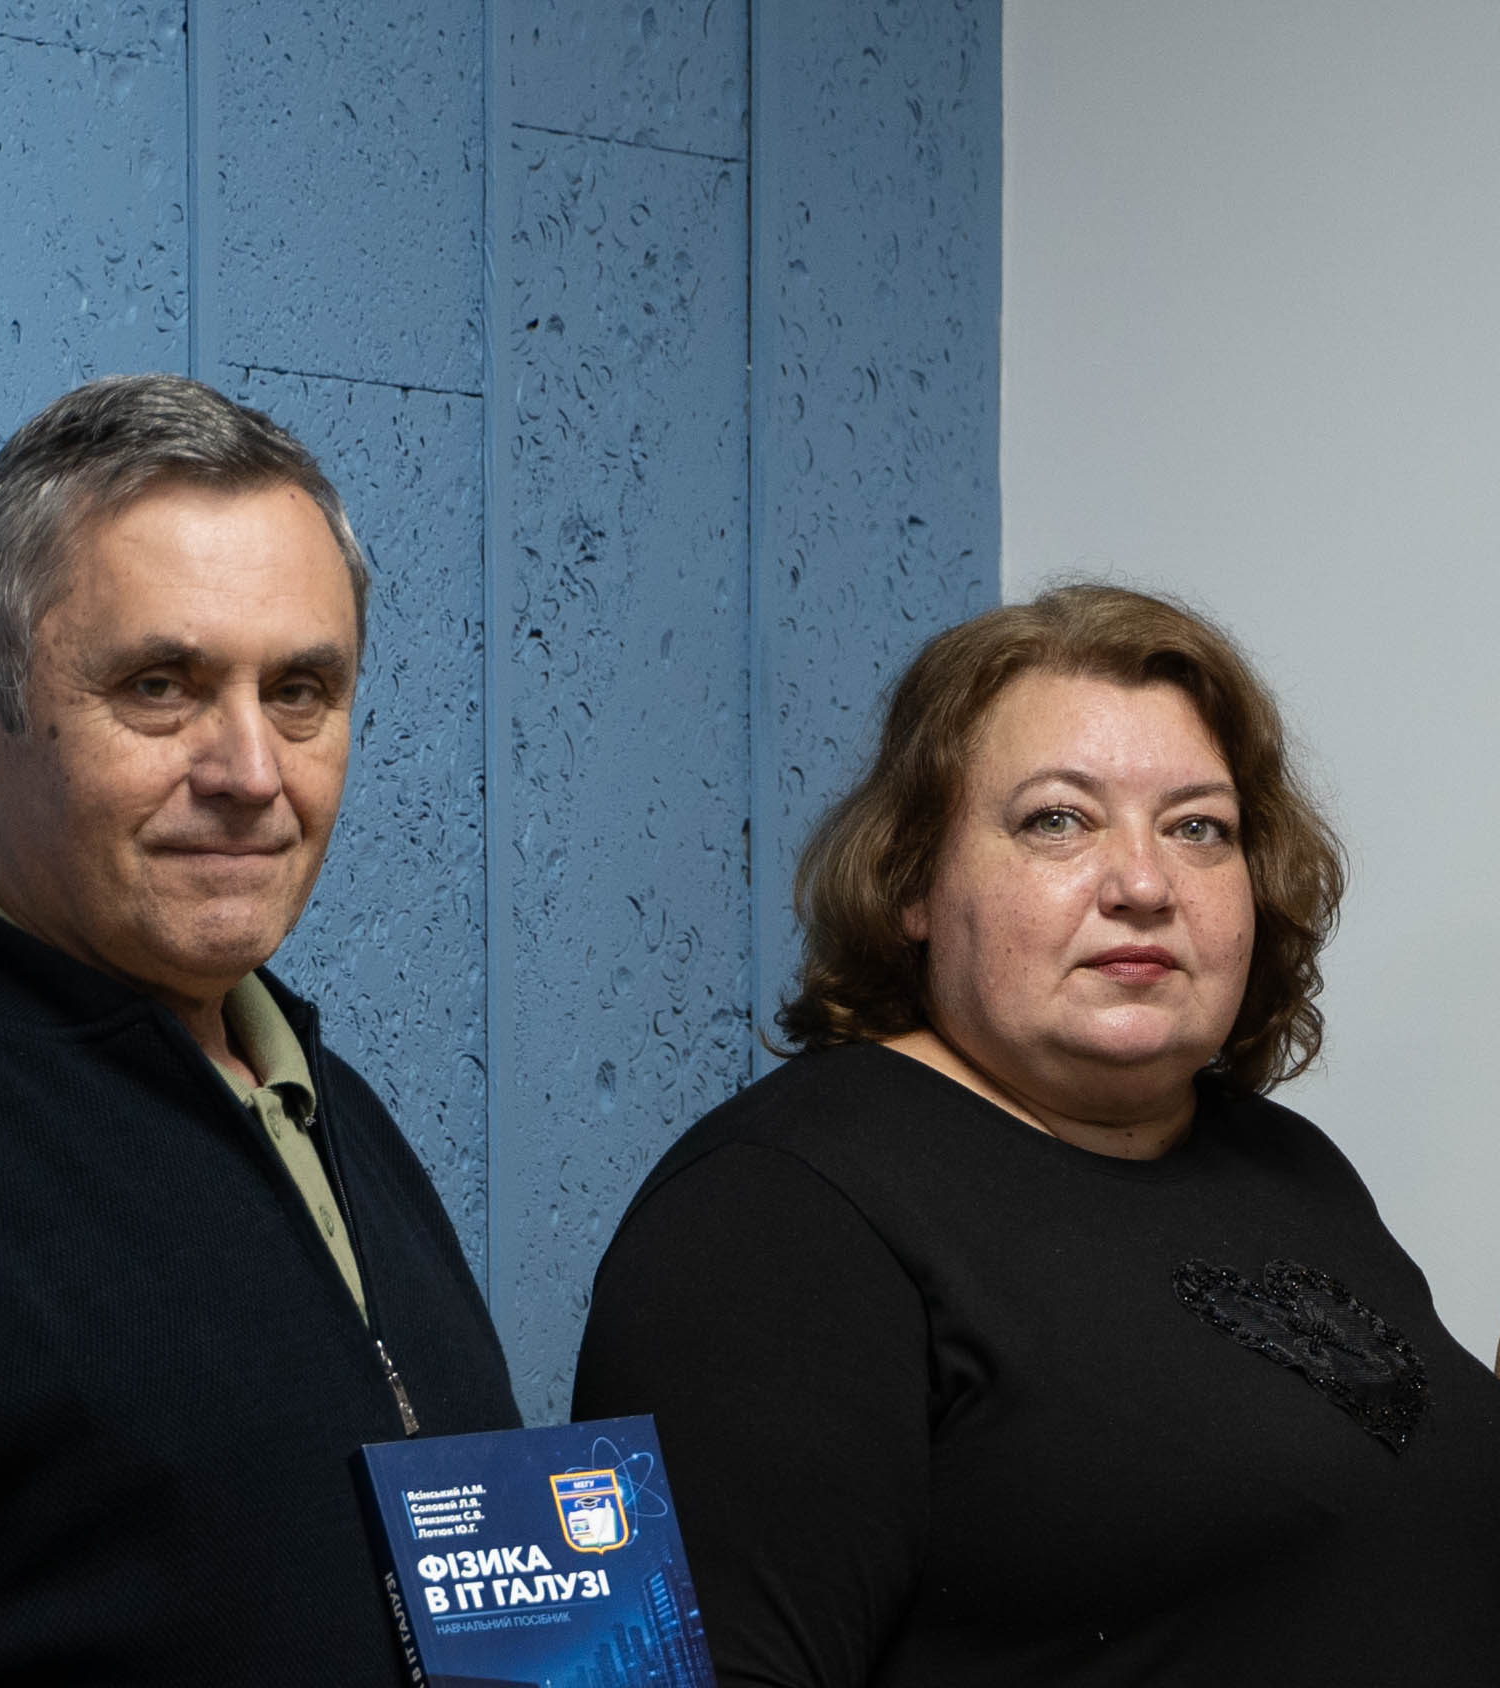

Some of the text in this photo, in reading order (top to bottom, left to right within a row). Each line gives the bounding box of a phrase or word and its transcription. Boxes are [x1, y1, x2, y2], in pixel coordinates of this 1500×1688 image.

[411, 1500, 457, 1513] Соловей
[417, 1545, 552, 1582] ФІЗИКА
[424, 1569, 611, 1613] В ІТ ГАЛУЗІ
[385, 1571, 411, 1642] ГАЛУЗІ
[436, 1611, 571, 1635] НАВЧАЛЬНИЙ ПОСІБНИК
[411, 1666, 422, 1682] В
